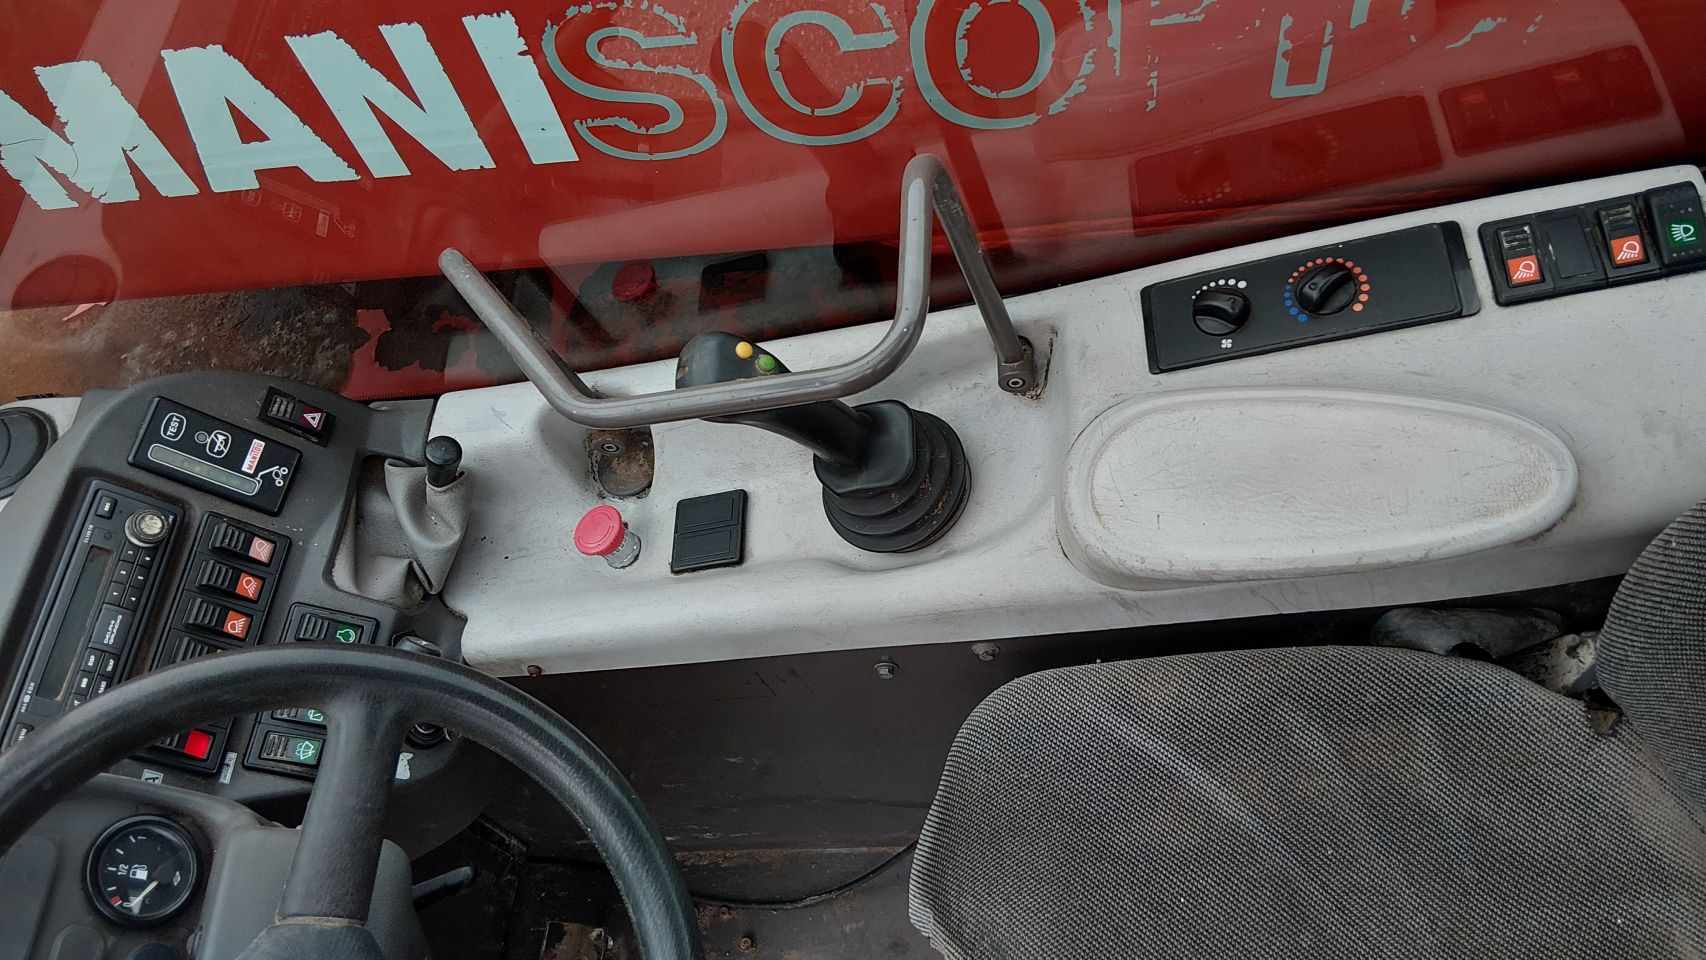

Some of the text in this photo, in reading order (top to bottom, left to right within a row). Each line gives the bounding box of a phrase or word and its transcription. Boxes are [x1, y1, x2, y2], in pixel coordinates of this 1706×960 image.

[166, 415, 181, 437] TEST
[246, 441, 264, 473] MANITOU
[108, 614, 123, 646] GRUNDIG
[117, 863, 129, 876] 1/2
